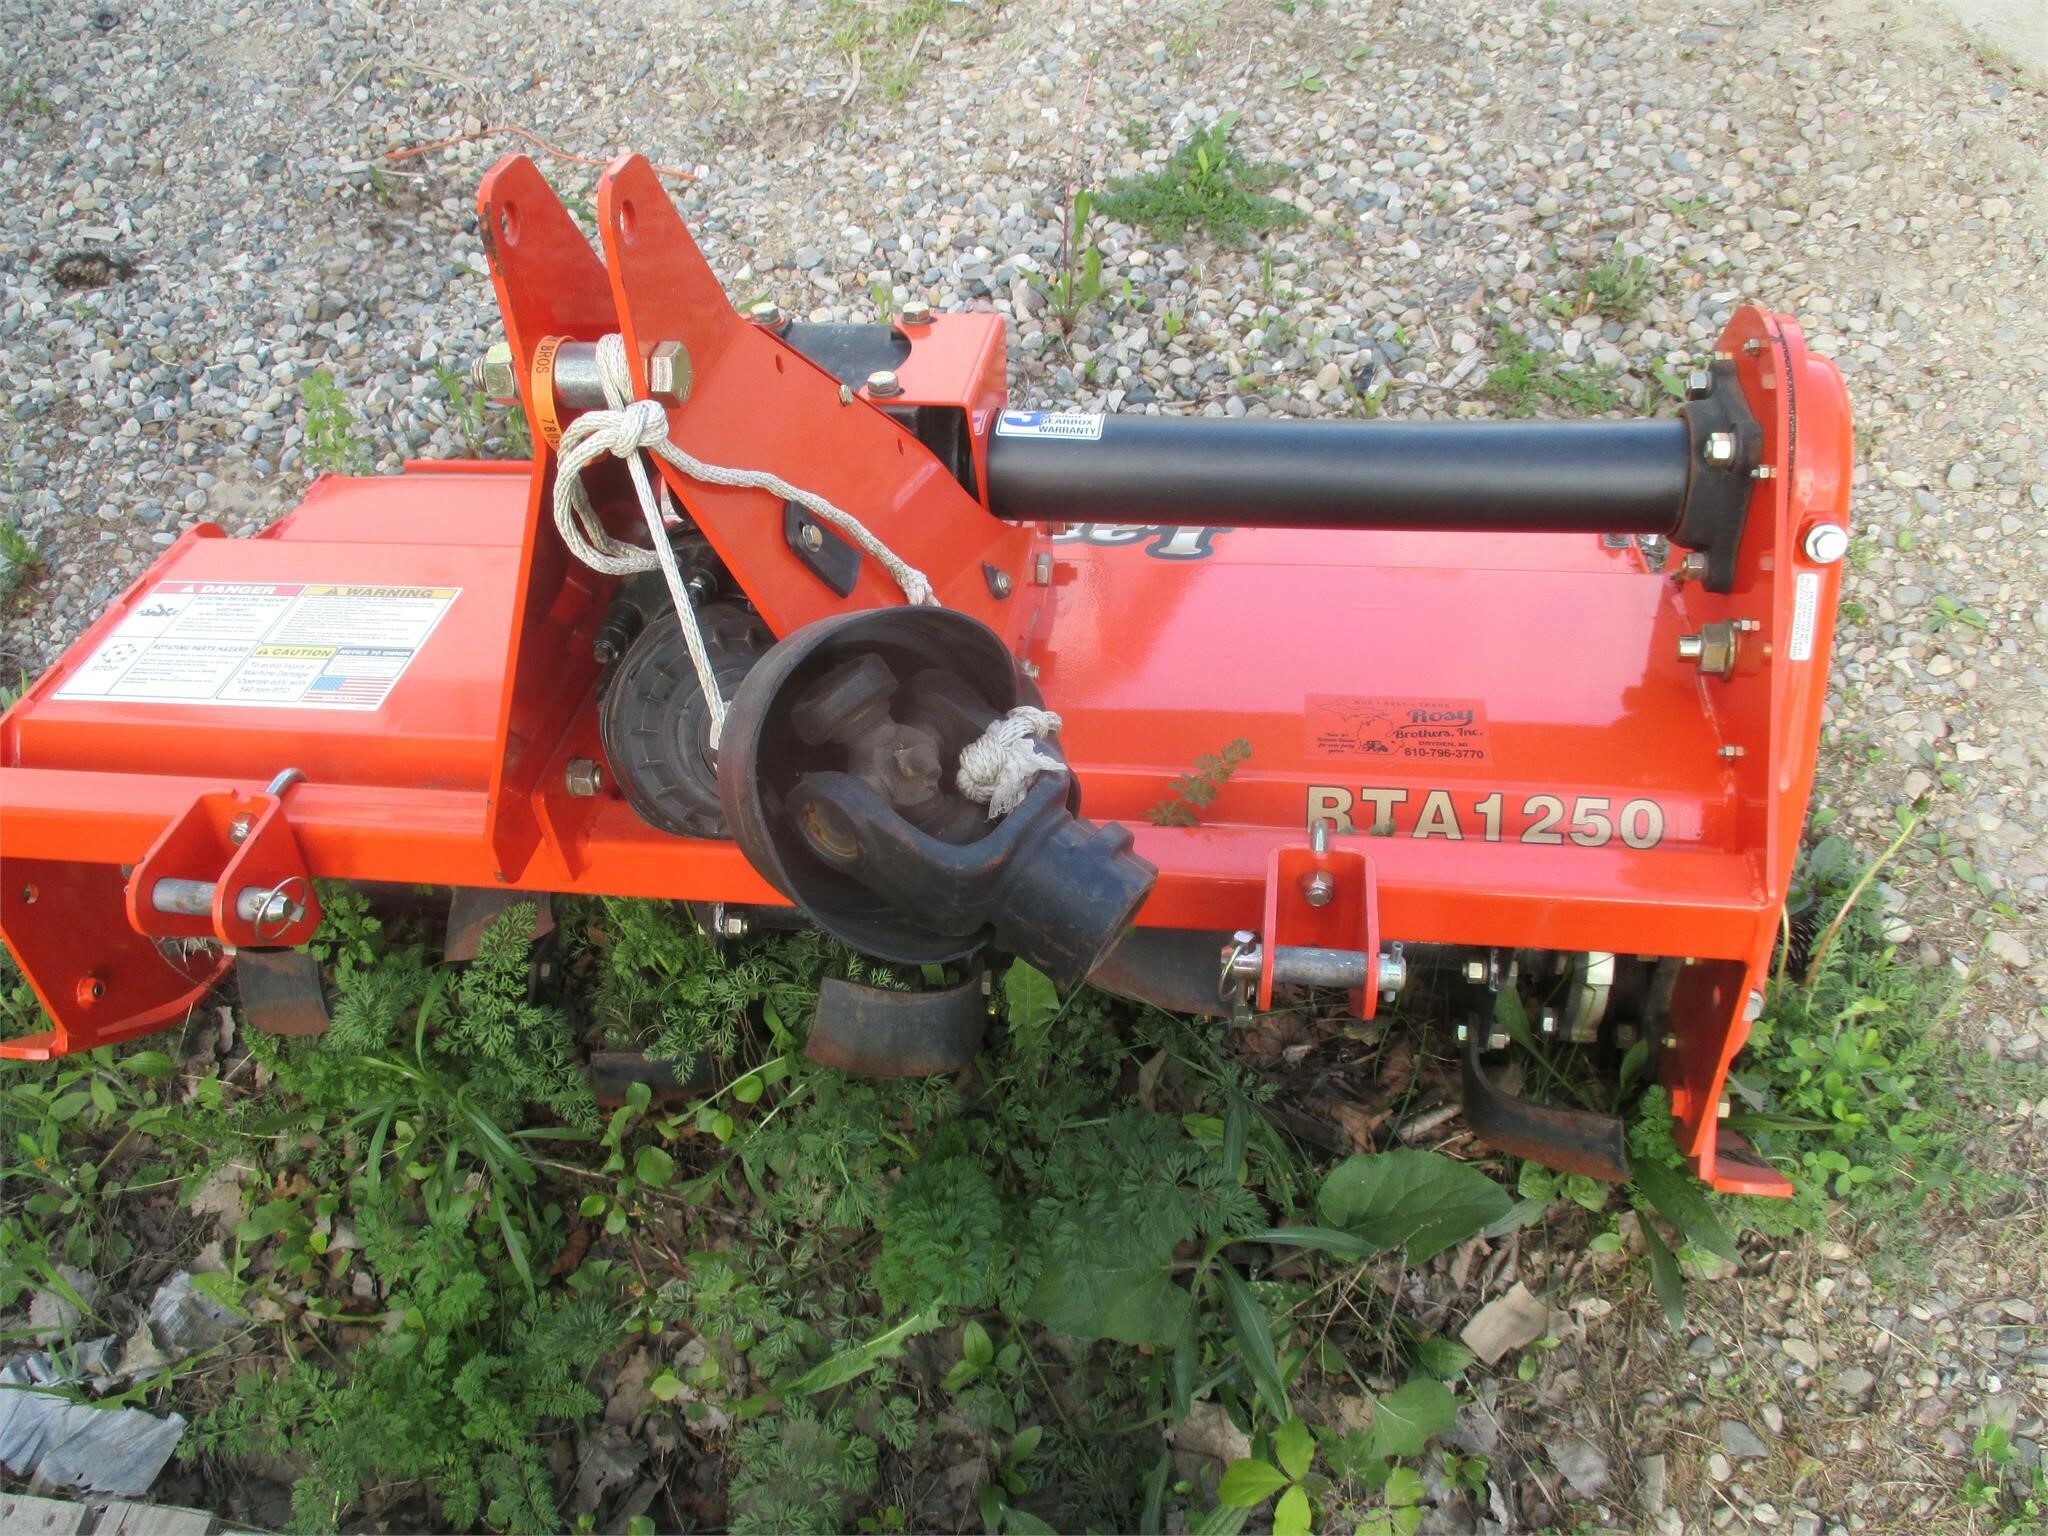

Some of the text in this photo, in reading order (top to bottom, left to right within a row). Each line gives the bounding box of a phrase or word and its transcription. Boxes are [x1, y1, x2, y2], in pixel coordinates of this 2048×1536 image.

[536, 345, 554, 373] BROS
[1039, 426, 1096, 434] WARRANTY
[200, 585, 276, 594] DANGER
[346, 587, 433, 598] WARNING
[272, 648, 332, 657] CAUTION
[1406, 708, 1474, 725] Rosy
[1393, 727, 1483, 739] Brothers, Inc.
[1306, 784, 1666, 850] RTA1250
